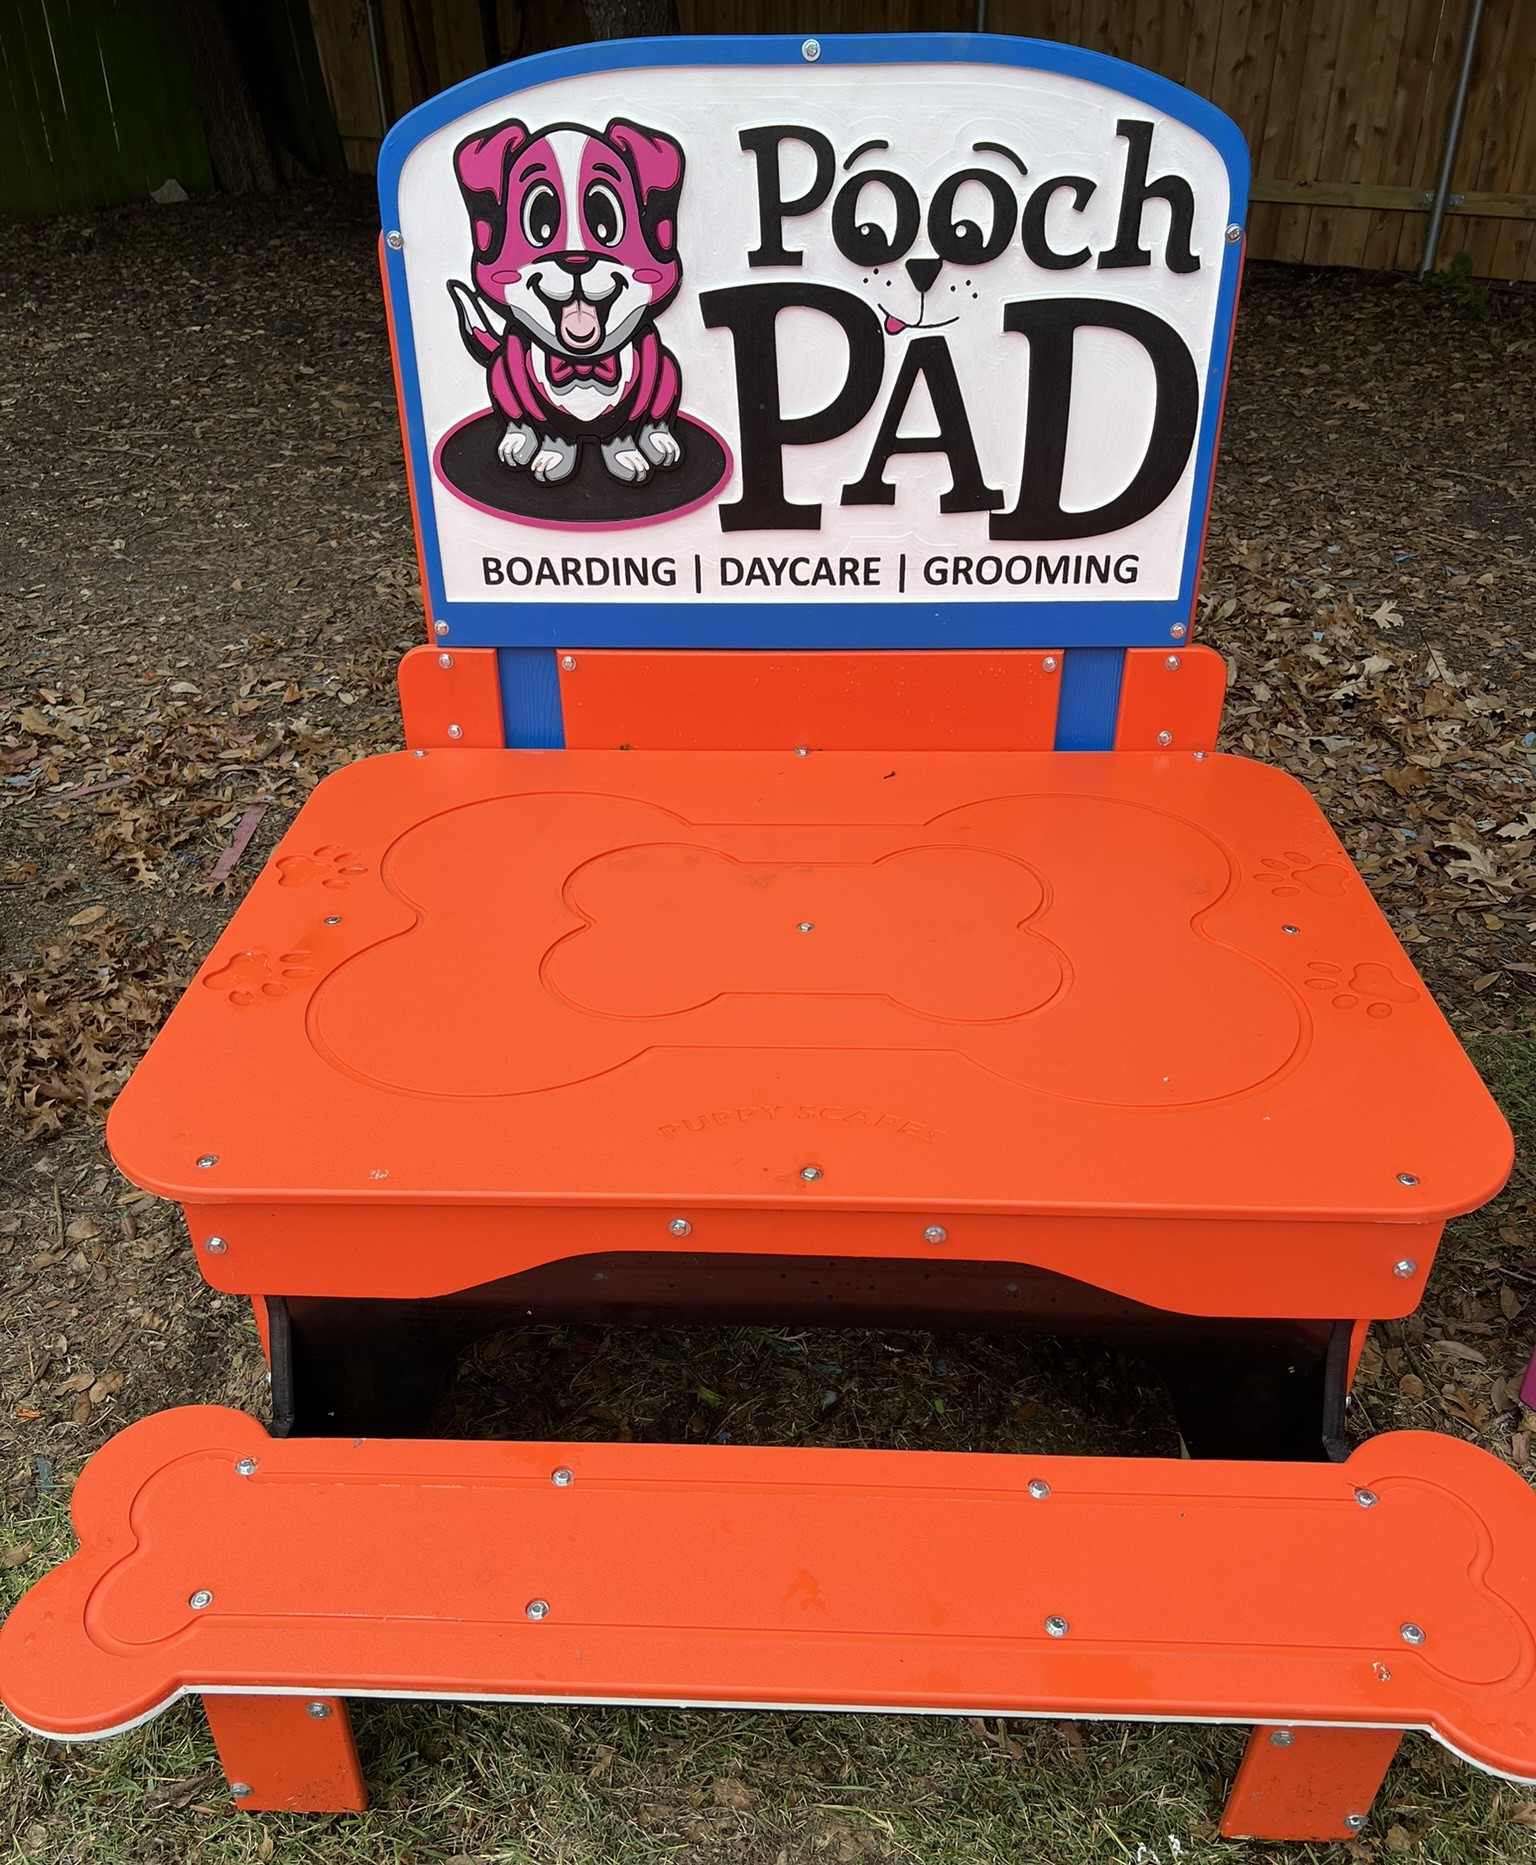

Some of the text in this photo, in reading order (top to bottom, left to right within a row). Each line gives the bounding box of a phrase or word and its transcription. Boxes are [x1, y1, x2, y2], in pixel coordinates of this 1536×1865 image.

[738, 119, 1200, 274] Pooch
[699, 281, 1199, 541] PAD
[482, 556, 677, 586] BOARDING
[720, 555, 881, 586] DAYCARE
[922, 553, 1139, 586] GROOMING
[658, 1105, 947, 1141] PUPPY SCAPES
